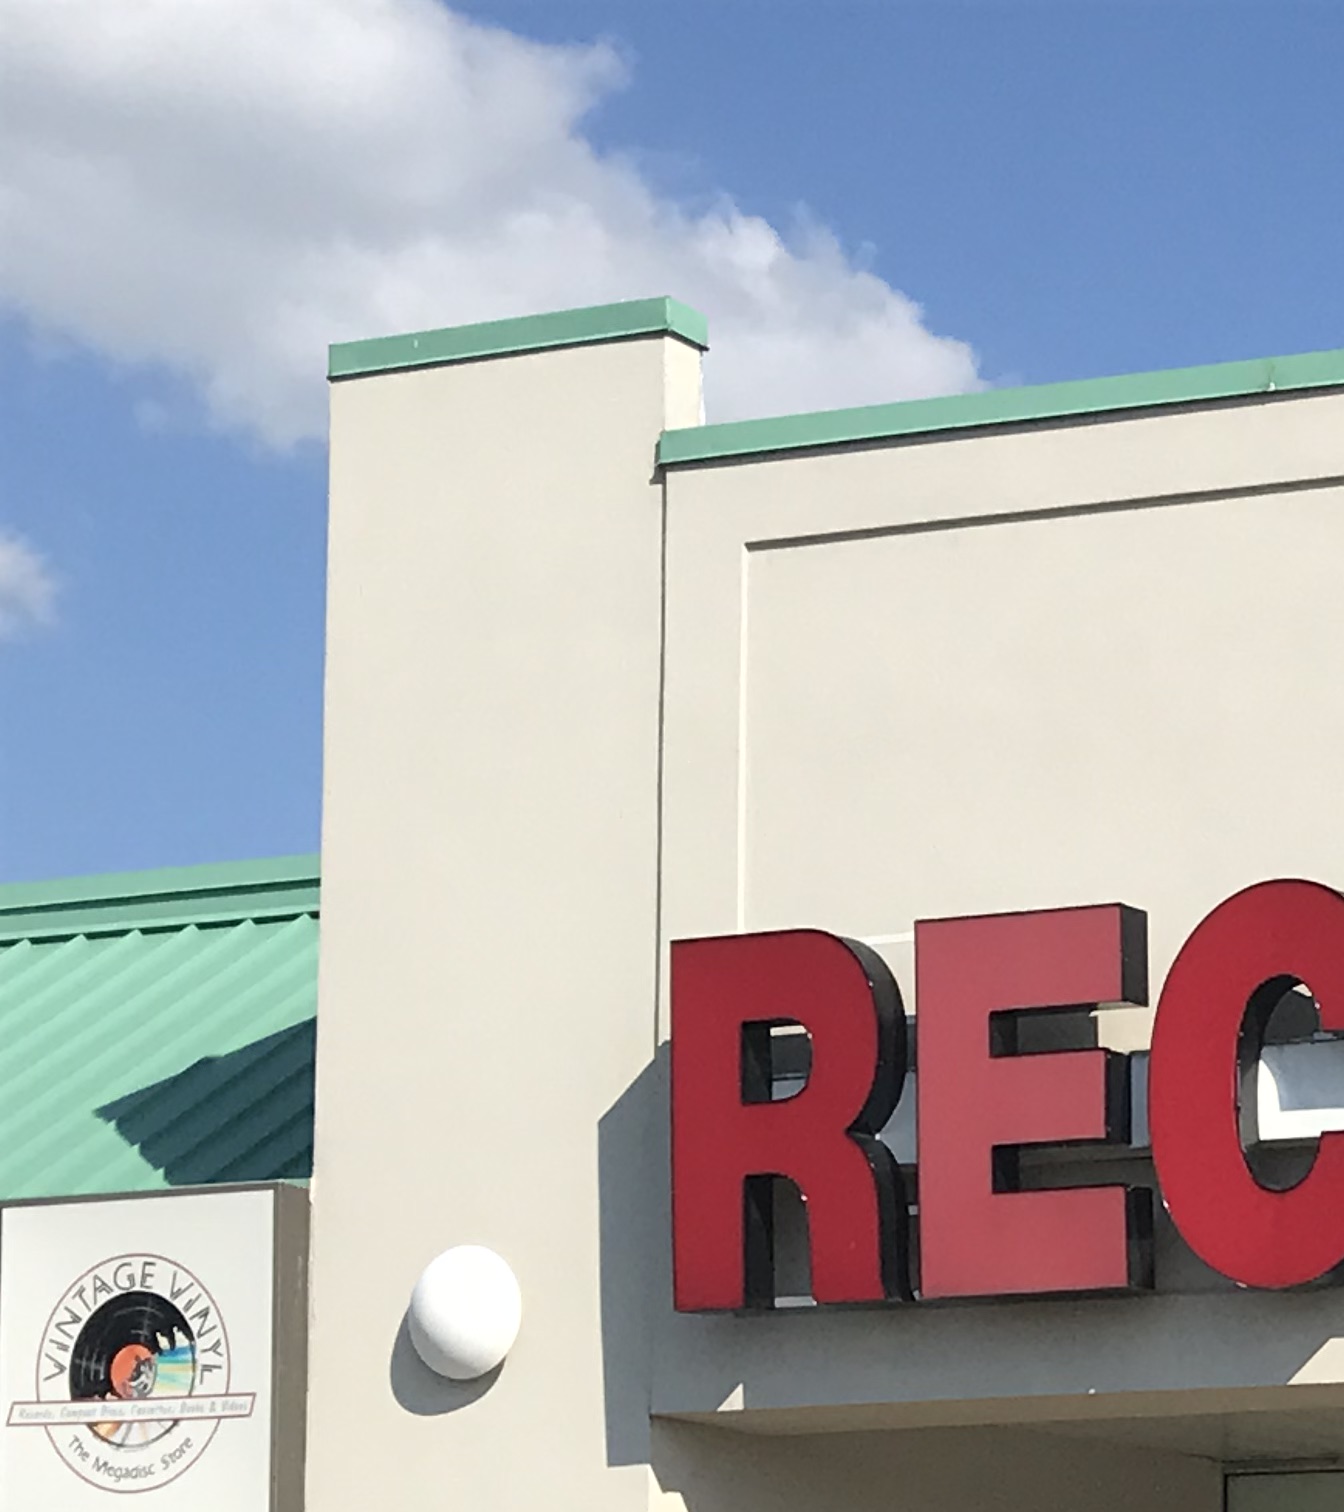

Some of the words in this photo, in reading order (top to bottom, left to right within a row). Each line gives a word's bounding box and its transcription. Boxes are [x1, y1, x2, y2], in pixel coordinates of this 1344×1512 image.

[42, 1261, 157, 1382] VINTAGE
[168, 1270, 223, 1385] VINYL
[68, 1433, 91, 1462] The
[92, 1457, 156, 1482] Megadisc
[160, 1436, 194, 1470] Store
